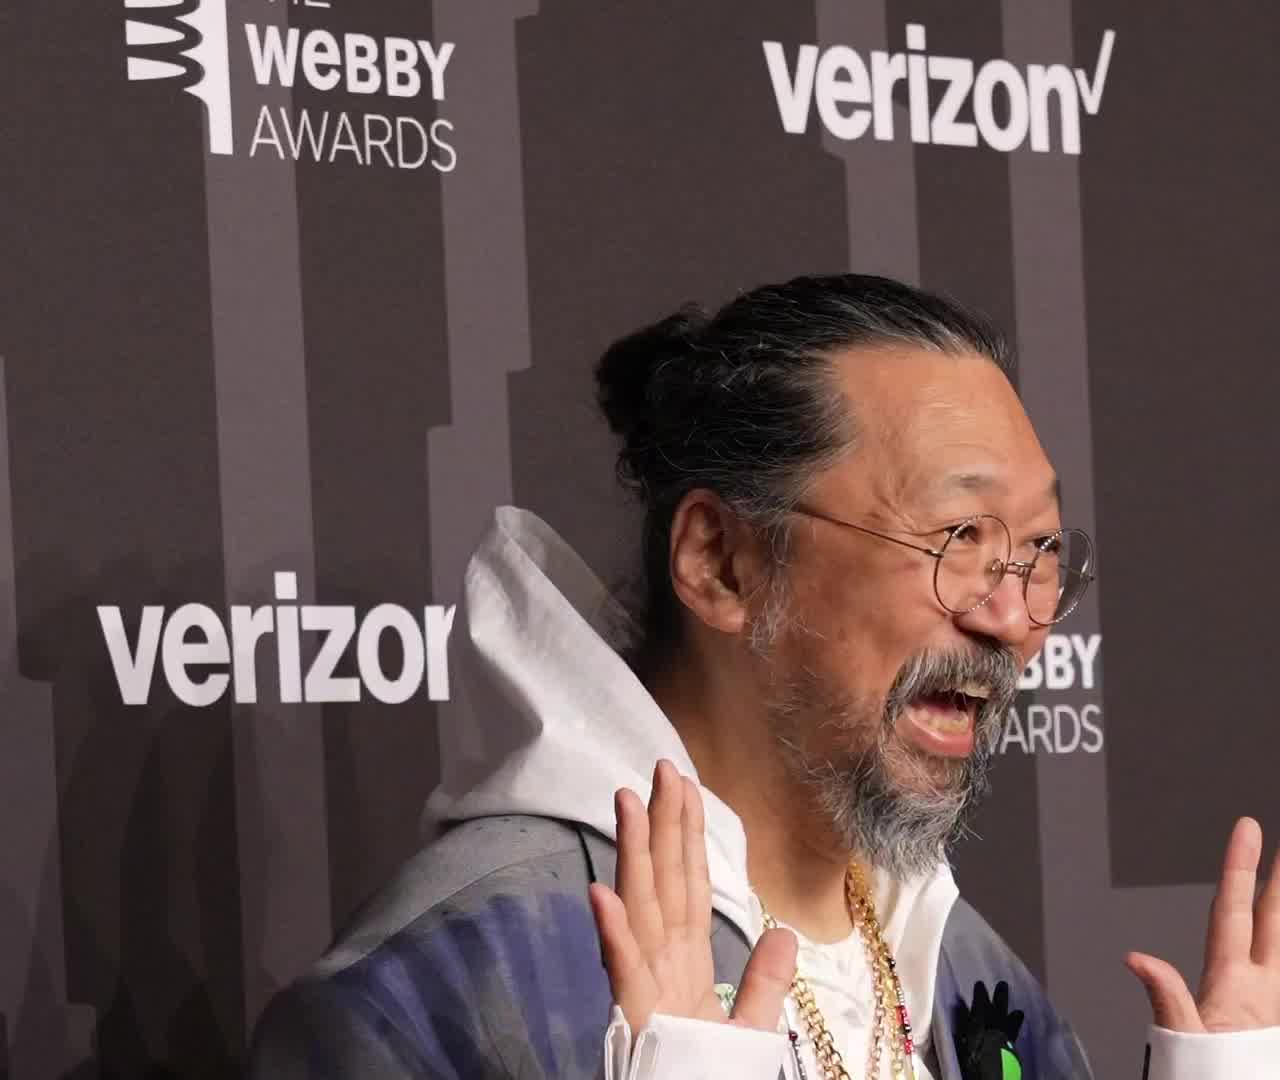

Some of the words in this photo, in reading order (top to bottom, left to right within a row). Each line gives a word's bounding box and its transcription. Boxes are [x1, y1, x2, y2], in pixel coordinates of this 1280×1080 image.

[245, 23, 456, 101] WeBBY
[762, 24, 1081, 155] verizon
[250, 105, 457, 172] AWARDS
[990, 703, 1104, 755] ARDS
